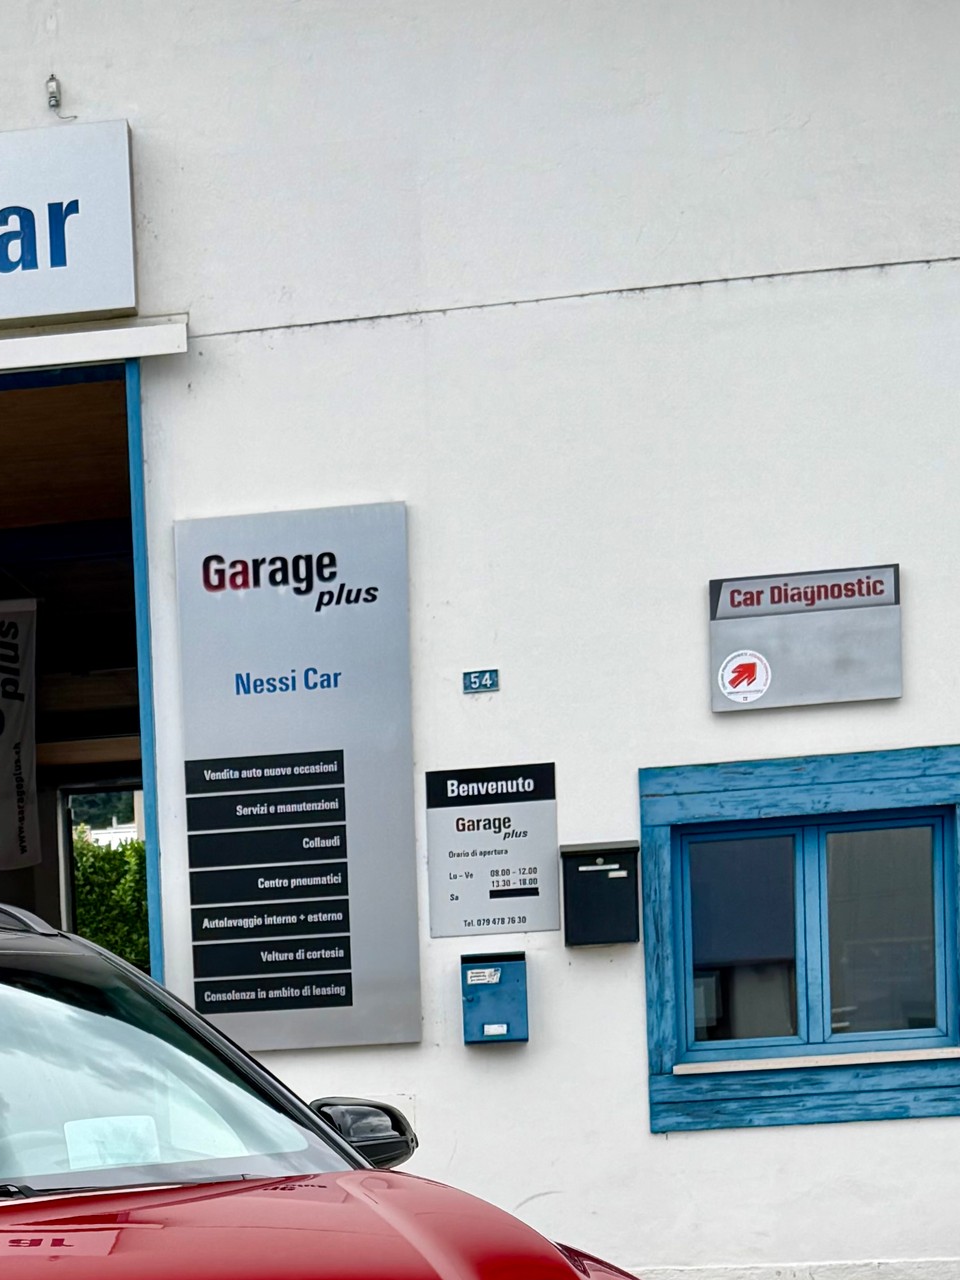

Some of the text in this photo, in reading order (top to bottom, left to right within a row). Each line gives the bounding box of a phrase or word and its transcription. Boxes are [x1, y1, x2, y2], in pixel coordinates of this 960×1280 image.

[202, 551, 337, 596] Garage
[315, 583, 379, 612] plus
[729, 576, 885, 608] Car Diagnostic
[235, 667, 342, 695] Nessi Car
[471, 672, 492, 688] 54
[204, 768, 239, 781] Vendita
[241, 767, 262, 778] auto
[294, 761, 338, 774] occasioni
[446, 776, 535, 798] Benvenuto
[236, 803, 268, 816] Servizi
[277, 799, 339, 813] manutenzioni
[456, 816, 512, 834] Garage
[302, 835, 340, 848] Collaudi
[503, 828, 528, 840] plus
[448, 848, 508, 859] Orario di apertura
[258, 873, 342, 889] Centro pneumatici
[465, 871, 474, 879] Ve
[450, 893, 459, 901] Sa
[202, 915, 262, 929] Autolavaggio
[264, 914, 297, 925] interno
[307, 912, 343, 922] esterno
[296, 948, 305, 960] di
[306, 947, 344, 960] cortesia
[257, 988, 266, 999] in
[268, 986, 300, 998] ambito
[302, 985, 311, 997] di
[312, 984, 346, 997] leasing
